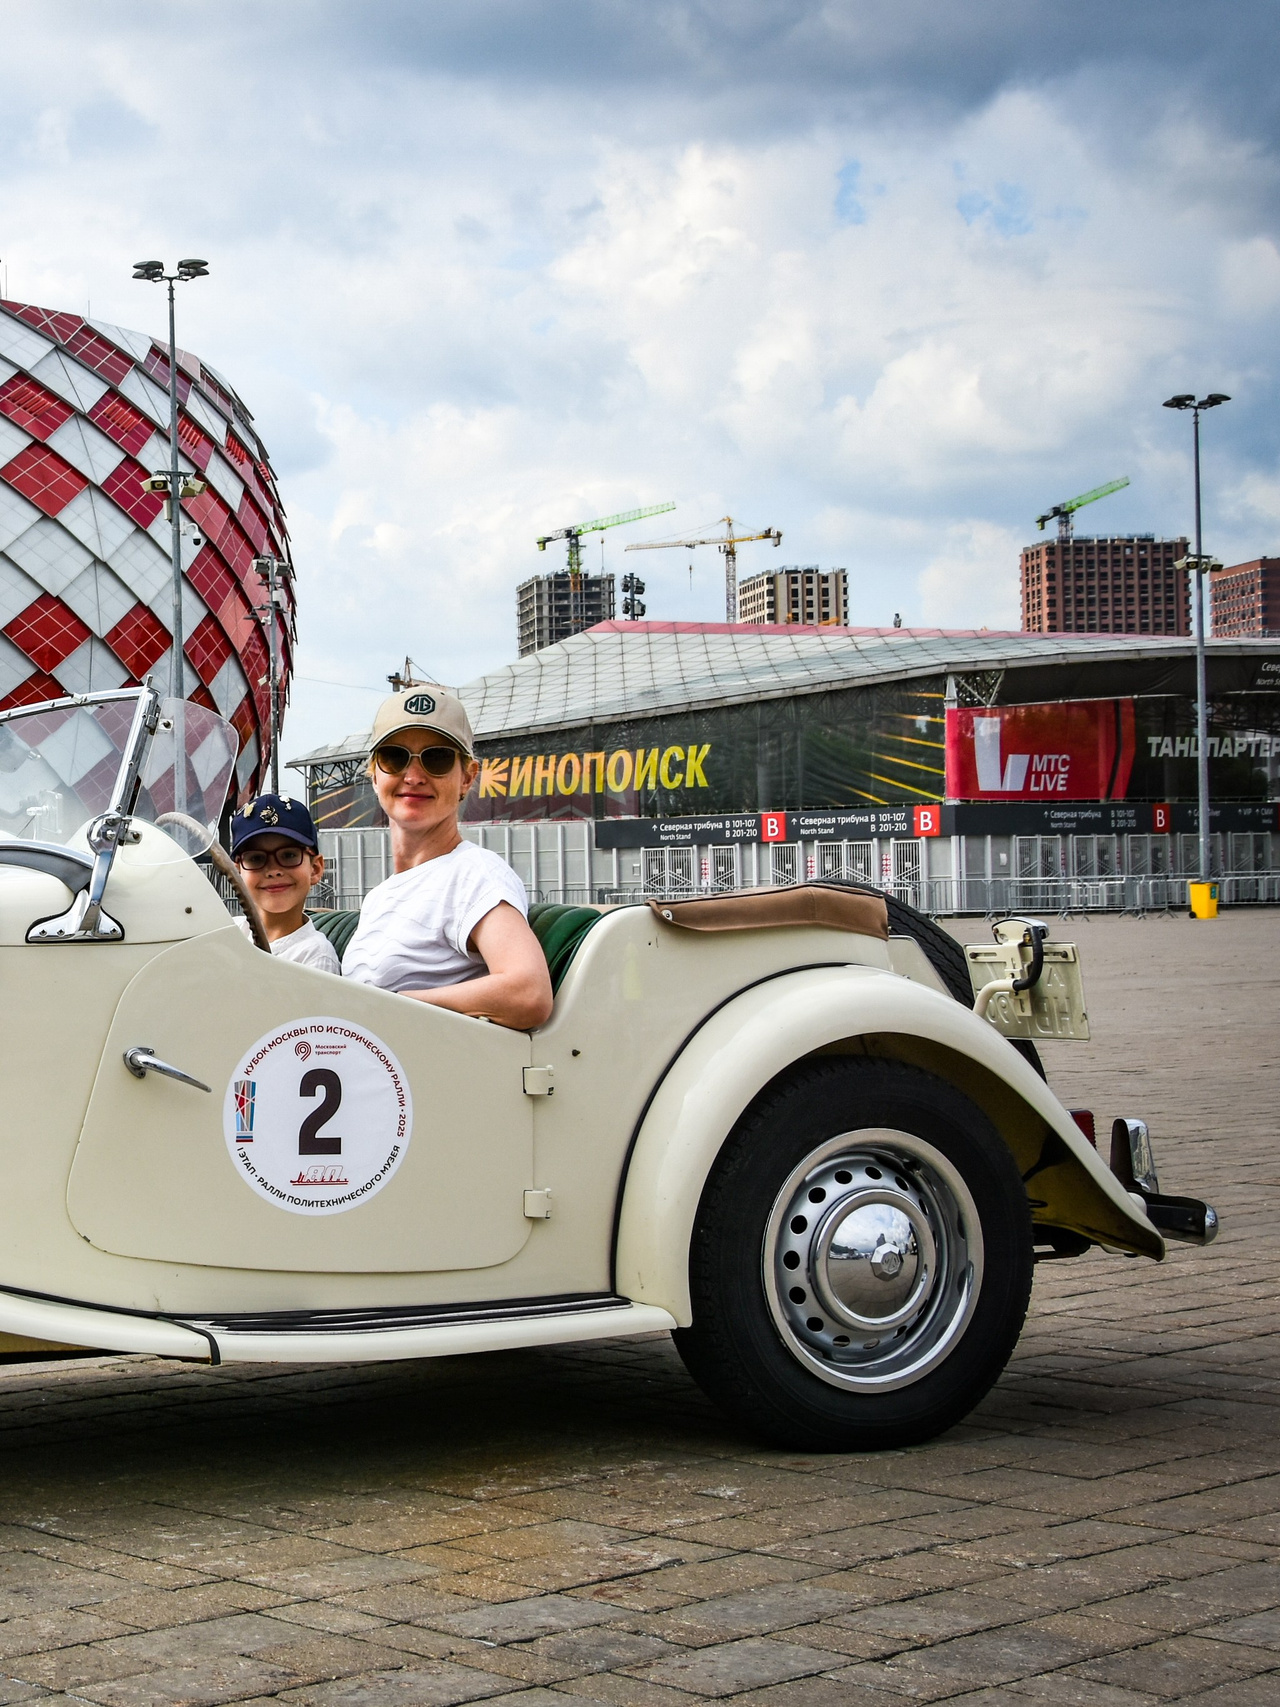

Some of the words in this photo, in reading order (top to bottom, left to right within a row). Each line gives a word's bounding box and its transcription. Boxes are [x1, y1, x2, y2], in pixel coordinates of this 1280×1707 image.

[407, 696, 433, 714] MG
[478, 743, 712, 799] КИНОПОИСК
[1029, 774, 1069, 792] LIVE
[659, 823, 693, 832] Северная
[694, 820, 723, 830] трибуна
[732, 819, 756, 828] 101-107
[800, 817, 836, 825] Северная
[837, 814, 869, 824] трибуна
[879, 812, 906, 822] 101-107
[732, 829, 758, 838] 201-210
[879, 822, 907, 832] 201-210
[310, 1025, 324, 1033] ПО
[267, 1027, 308, 1050] МОСКВЫ
[326, 1025, 395, 1073] ИСТОРИЧЕСКОМУ
[244, 1046, 269, 1076] КУБОК
[391, 1073, 407, 1107] РАЛЛИ
[298, 1068, 342, 1156] 2
[397, 1114, 407, 1137] 2025
[238, 1150, 257, 1175] ЭТАП
[257, 1176, 287, 1200] РАЛЛИ
[287, 1173, 382, 1208] ПОЛИТЕХНИЧЕСКОГО
[380, 1145, 401, 1175] МУЗЕЯ
